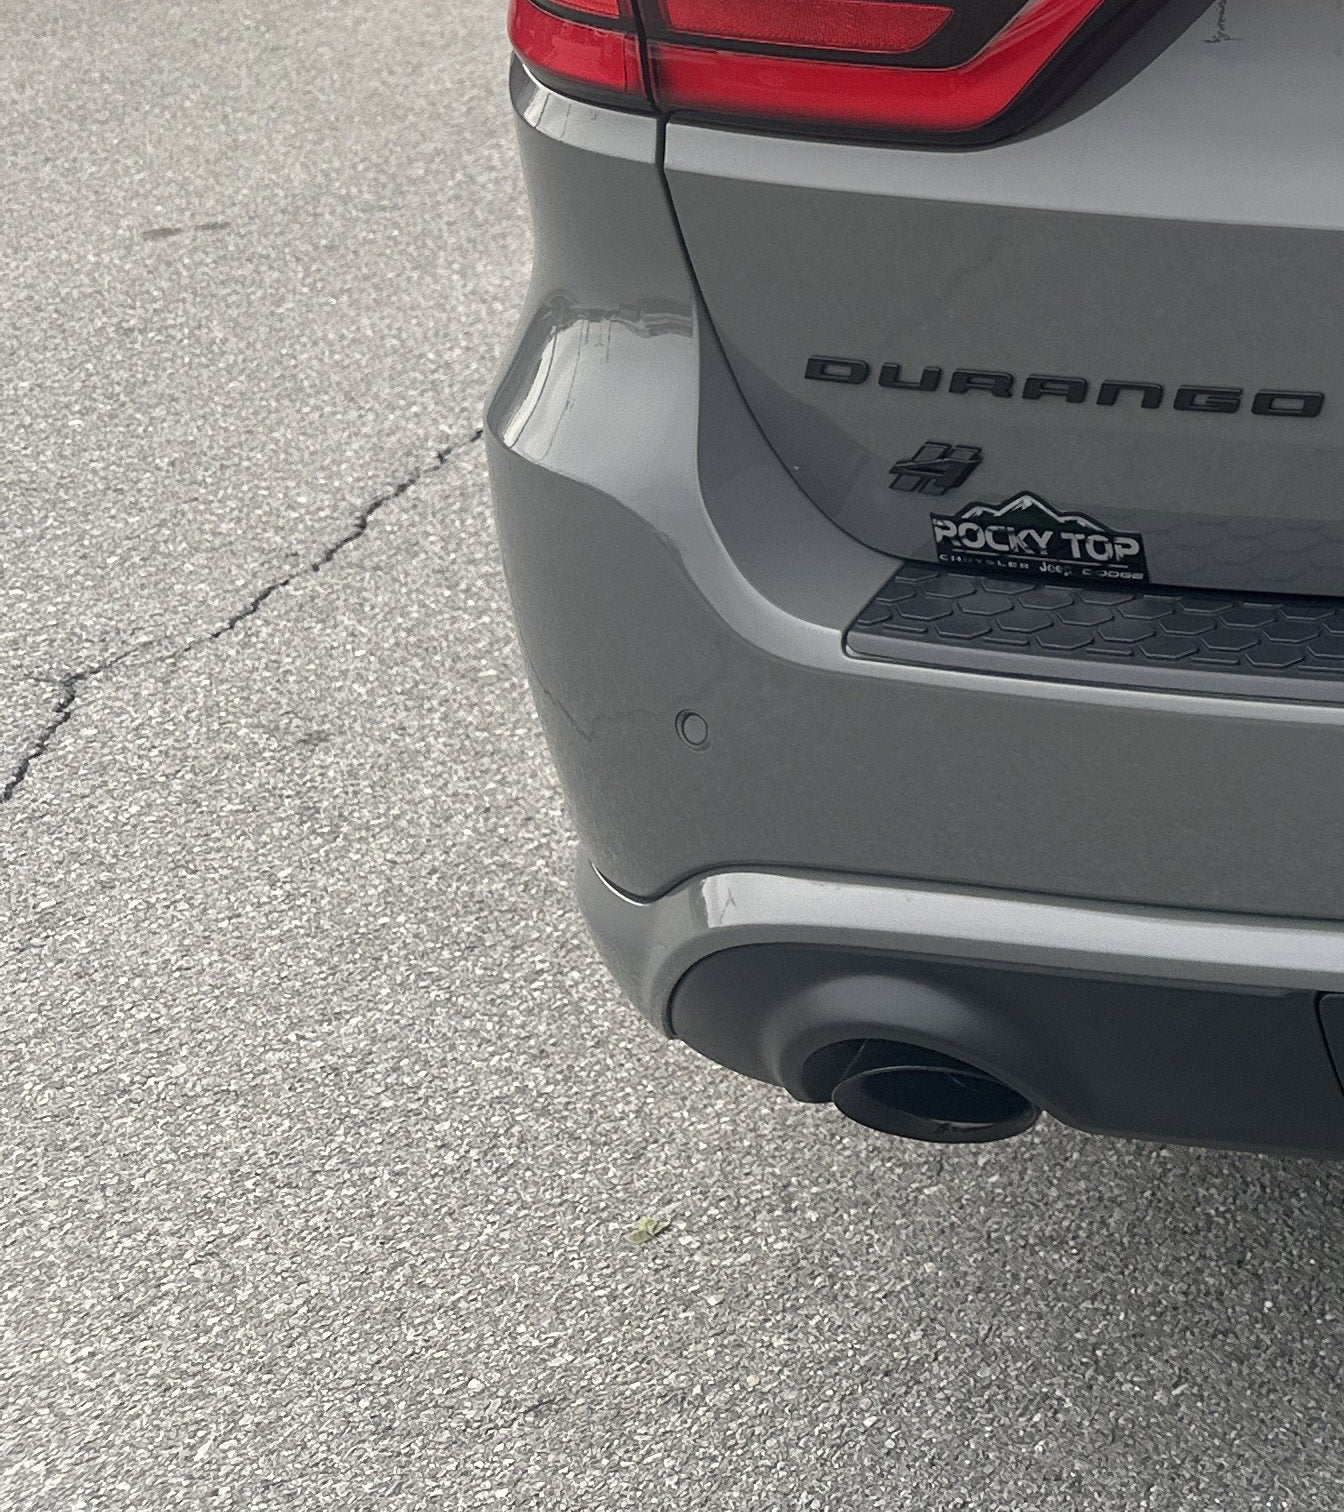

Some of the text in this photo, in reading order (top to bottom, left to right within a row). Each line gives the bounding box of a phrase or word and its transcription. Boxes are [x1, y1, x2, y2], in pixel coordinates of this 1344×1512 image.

[804, 355, 1325, 418] DURANGO
[932, 518, 1141, 562] ROCKY TOP
